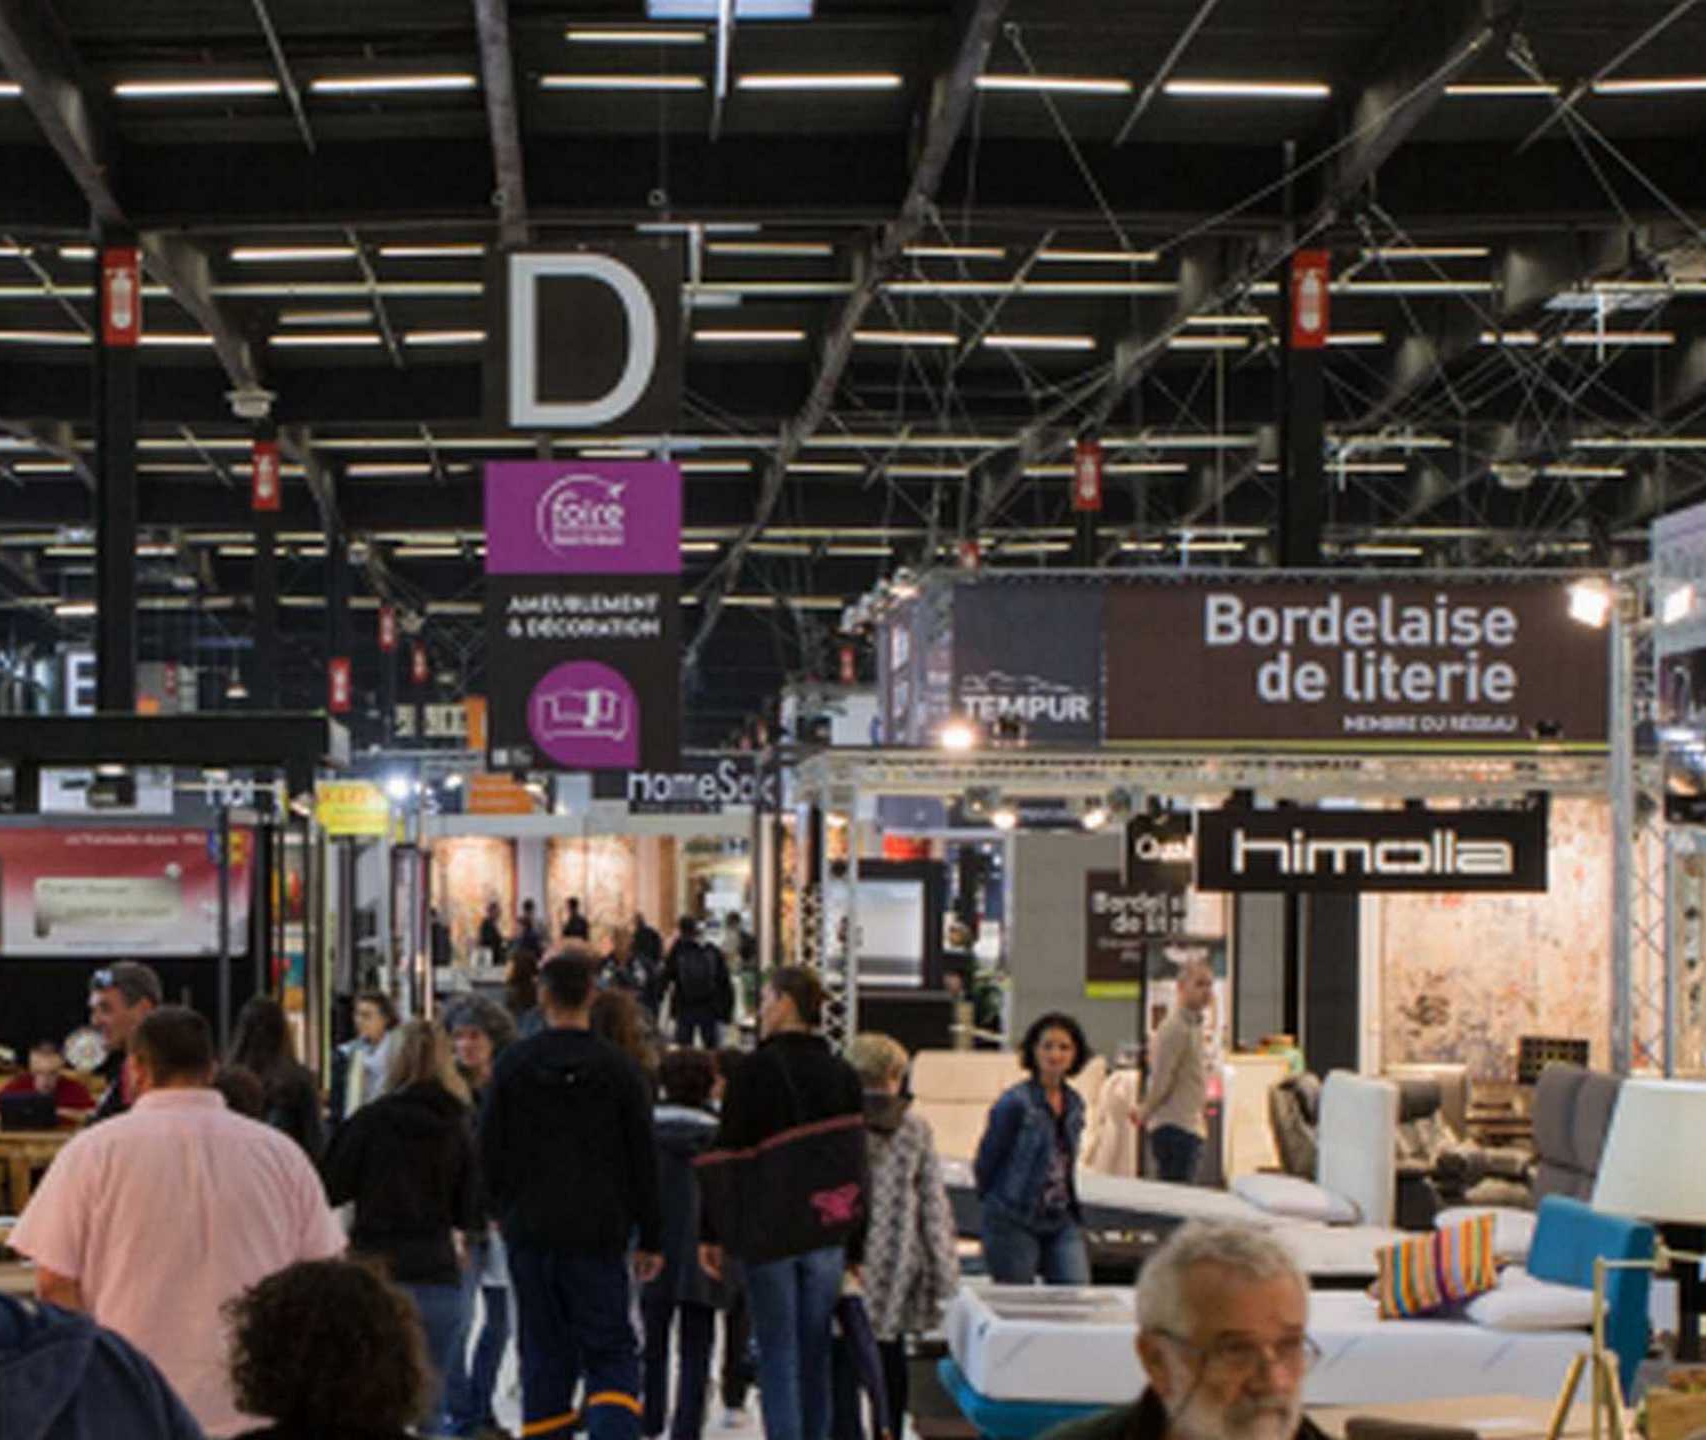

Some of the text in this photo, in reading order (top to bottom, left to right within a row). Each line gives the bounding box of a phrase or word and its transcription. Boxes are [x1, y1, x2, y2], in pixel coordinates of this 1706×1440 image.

[507, 252, 657, 428] D
[552, 491, 624, 528] foire
[506, 594, 660, 614] AMEUBLEMENT
[1204, 593, 1518, 646] Bordelaise
[526, 615, 660, 638] DÉCORATION
[1257, 650, 1518, 702] de literie
[961, 695, 1091, 722] TEMPUR
[1231, 827, 1515, 875] himolla
